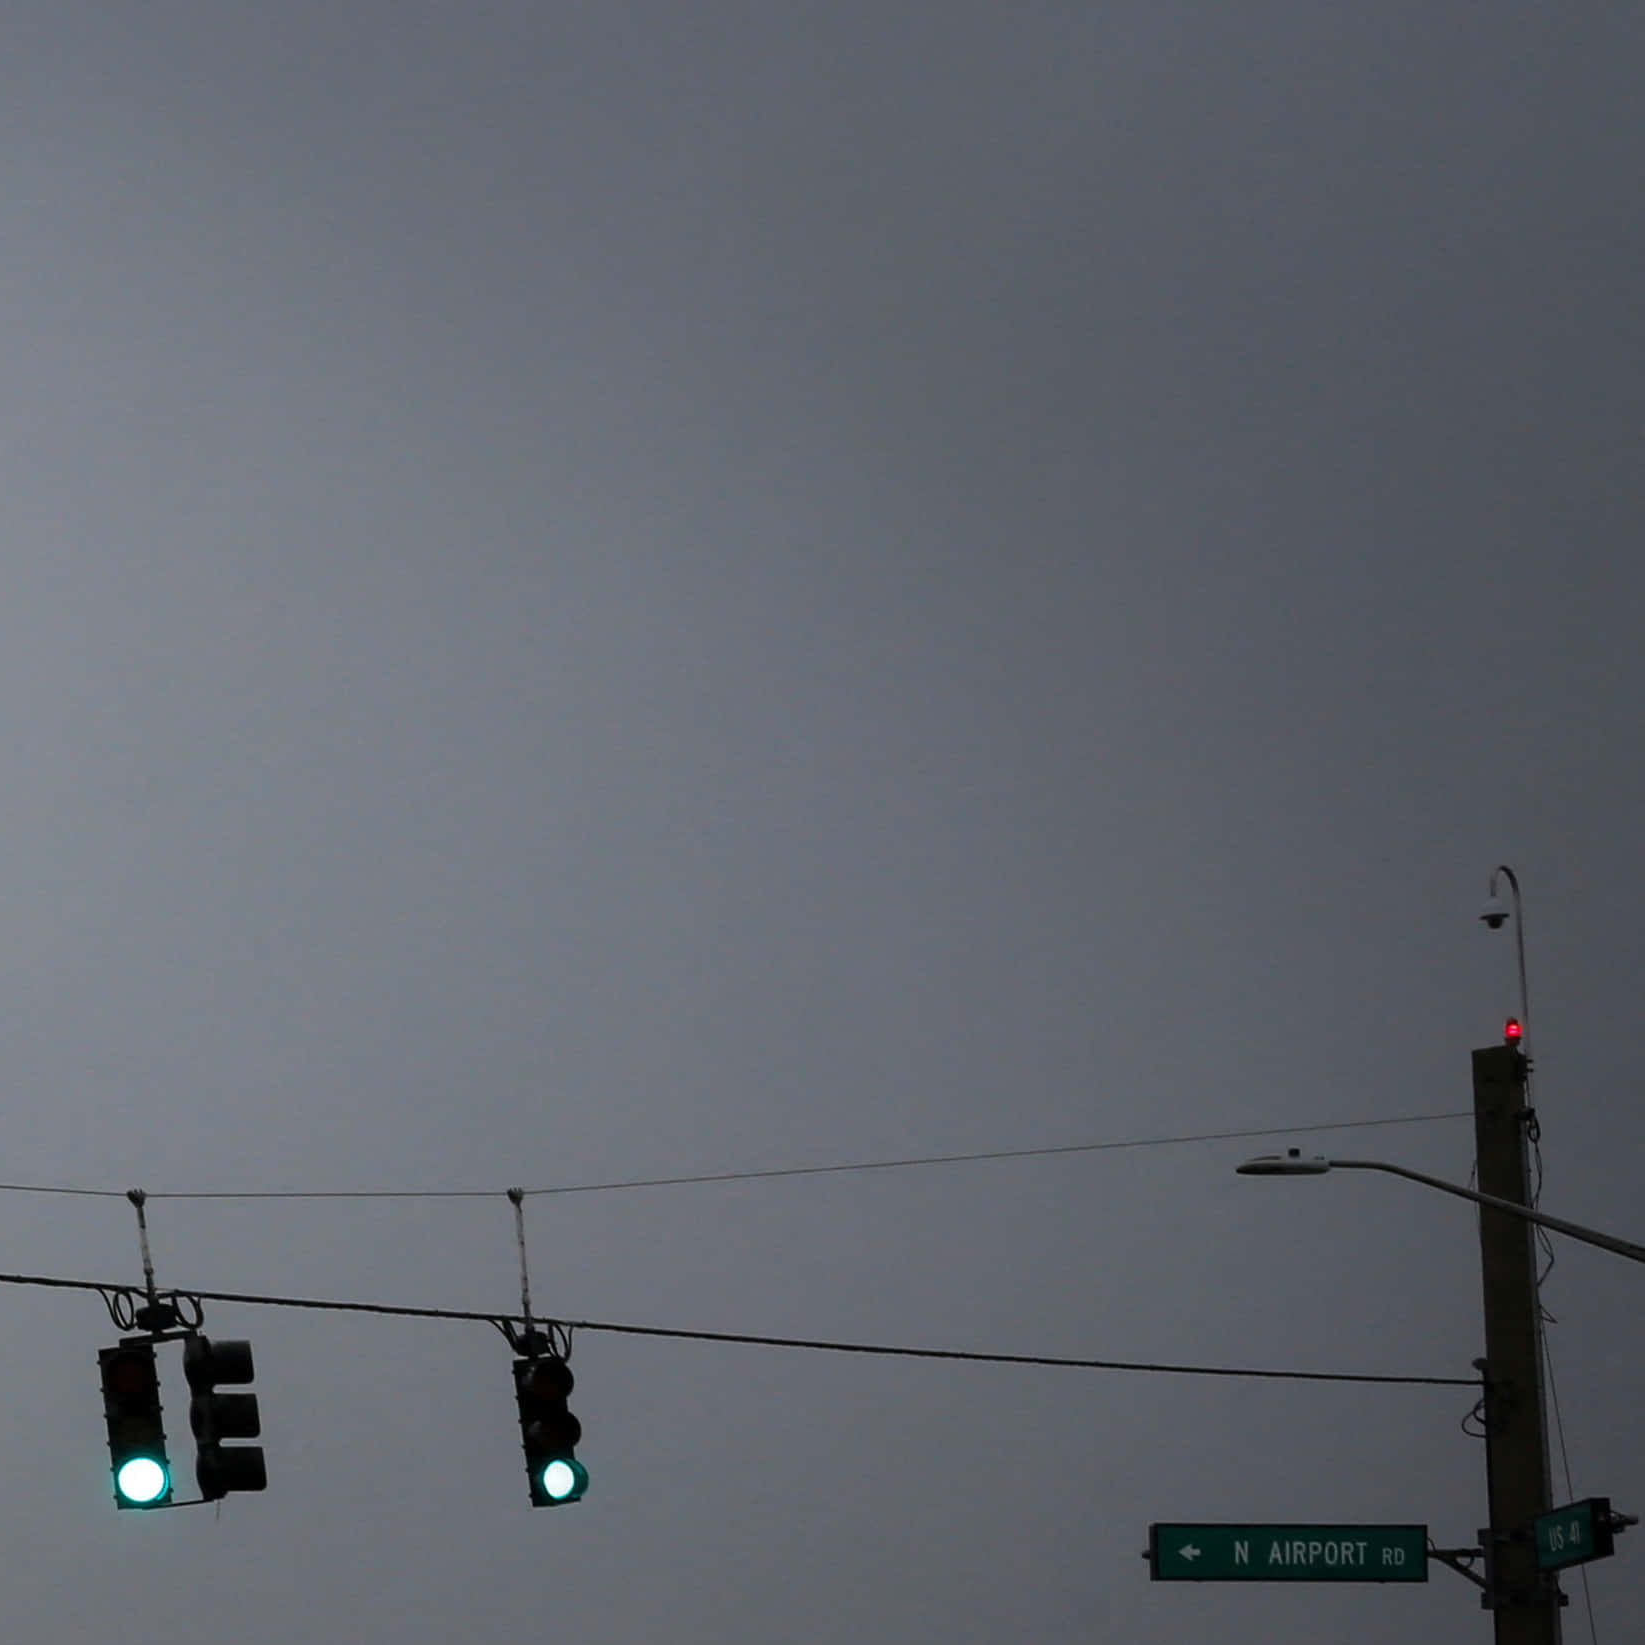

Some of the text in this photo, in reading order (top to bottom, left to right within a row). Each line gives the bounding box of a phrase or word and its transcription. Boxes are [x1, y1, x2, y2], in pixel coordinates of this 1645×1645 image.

[1549, 1520, 1581, 1552] US 41
[1235, 1540, 1406, 1566] N AIRPORT RD
